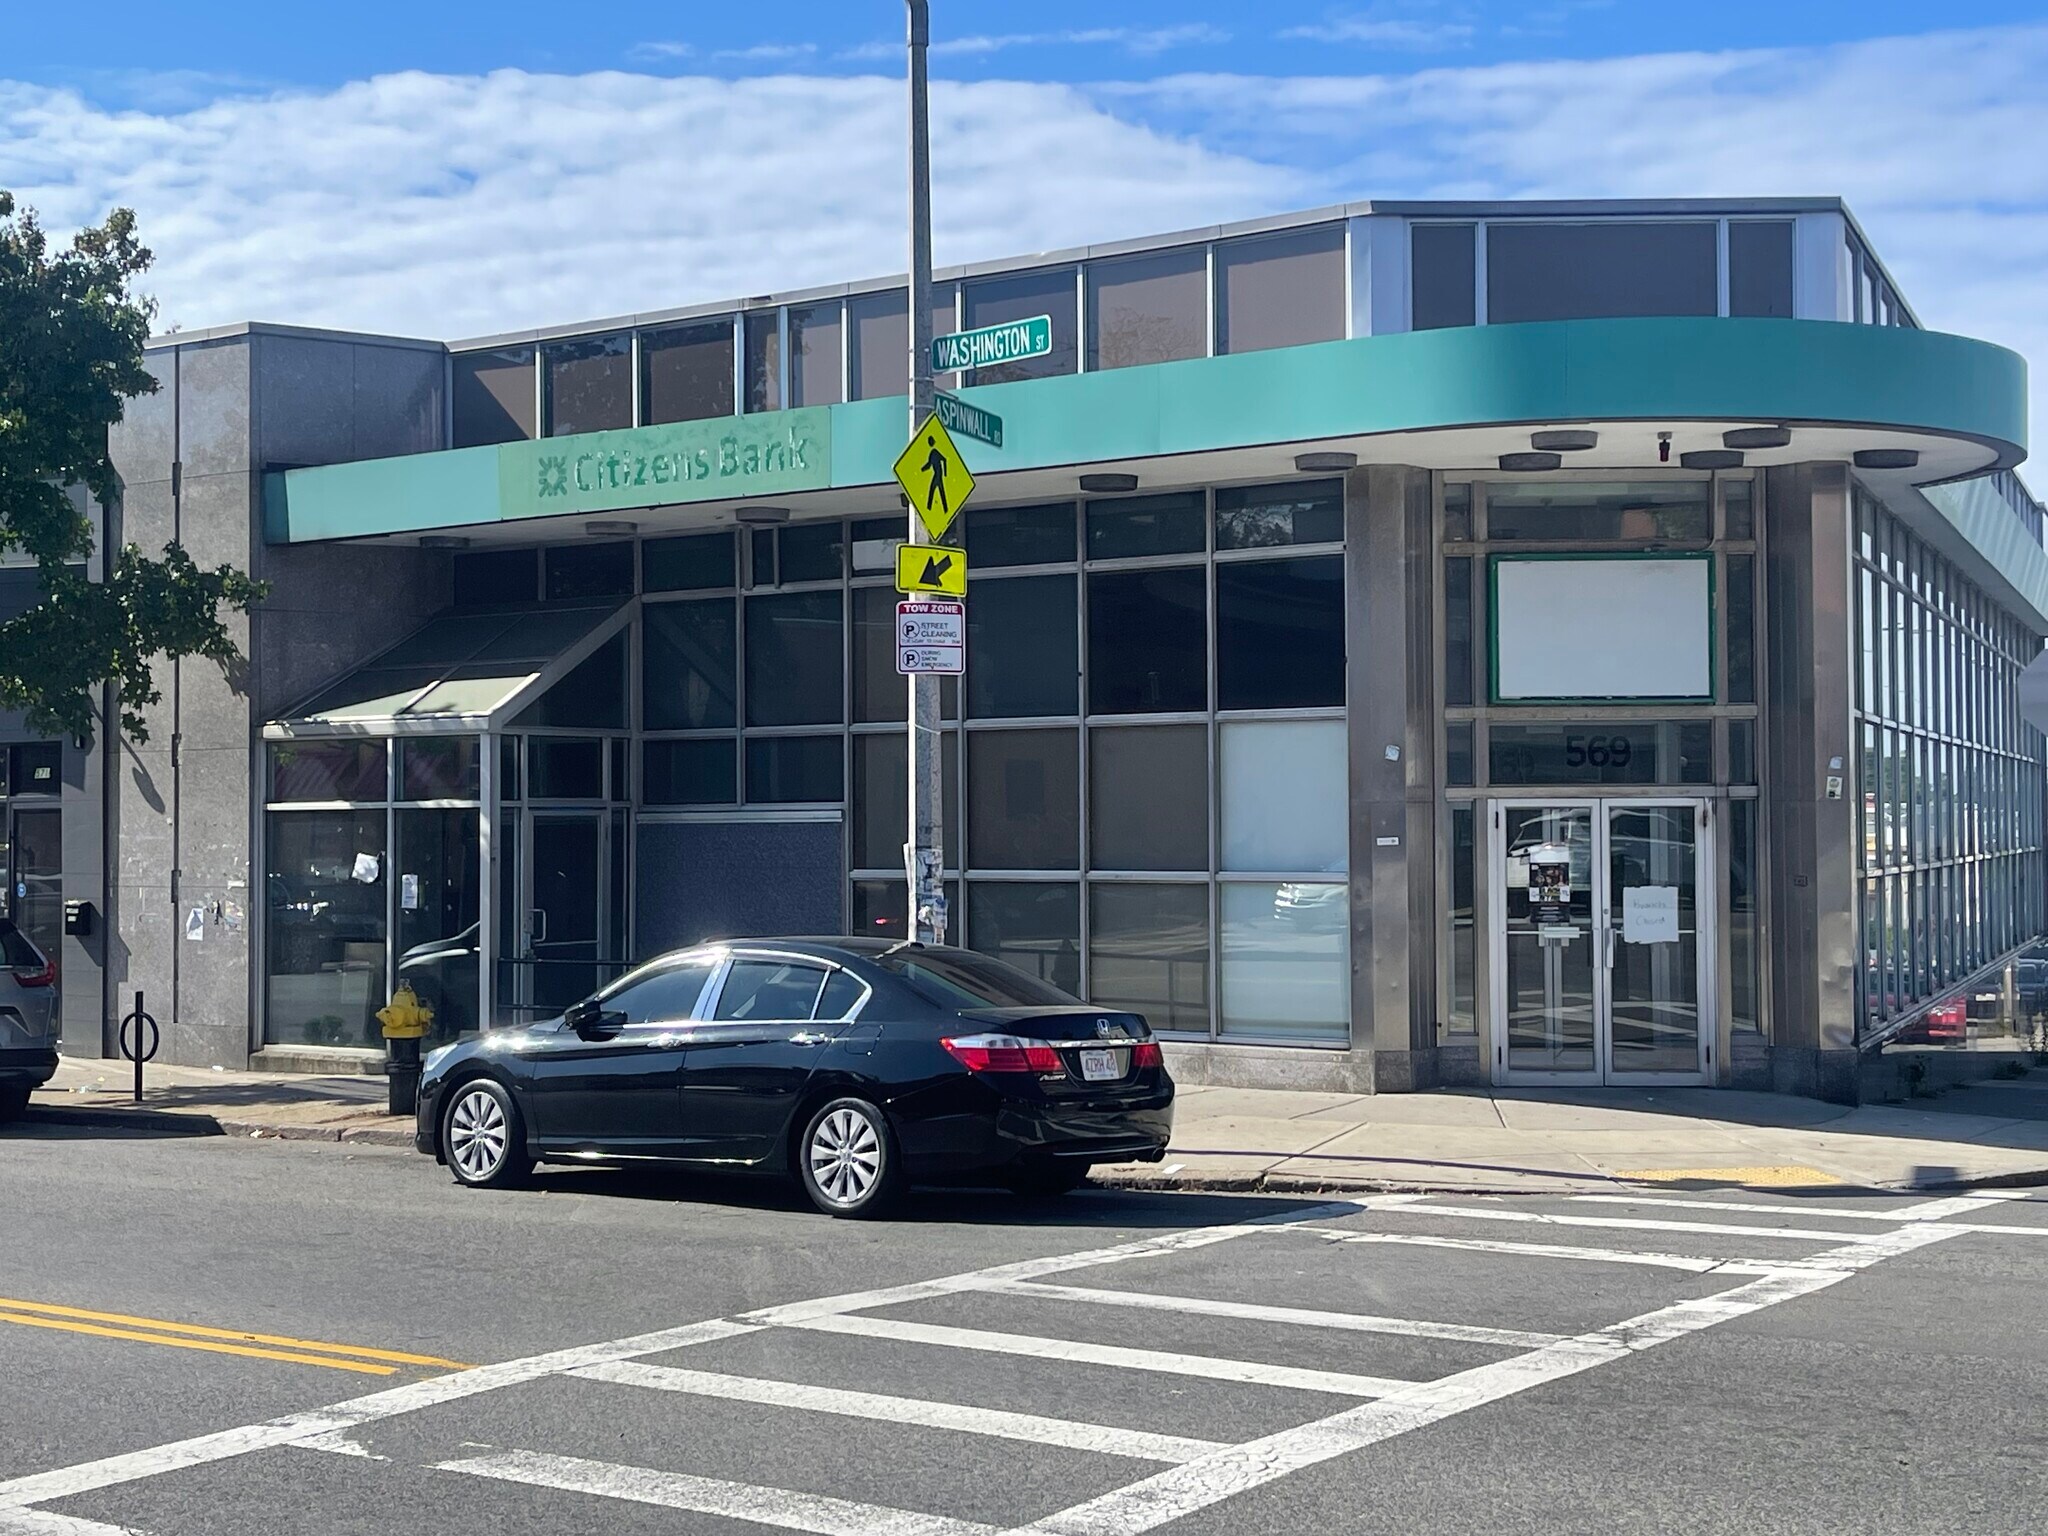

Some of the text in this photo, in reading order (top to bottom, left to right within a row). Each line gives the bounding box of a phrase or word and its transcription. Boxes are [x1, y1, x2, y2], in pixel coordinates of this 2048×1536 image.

[937, 325, 1045, 366] WASHINGTON ST
[935, 398, 991, 440] ASPINWALL
[574, 427, 810, 492] Citizens Bank
[904, 604, 958, 613] TOW ZONE
[920, 630, 957, 638] CLEANING
[1565, 735, 1632, 768] 569
